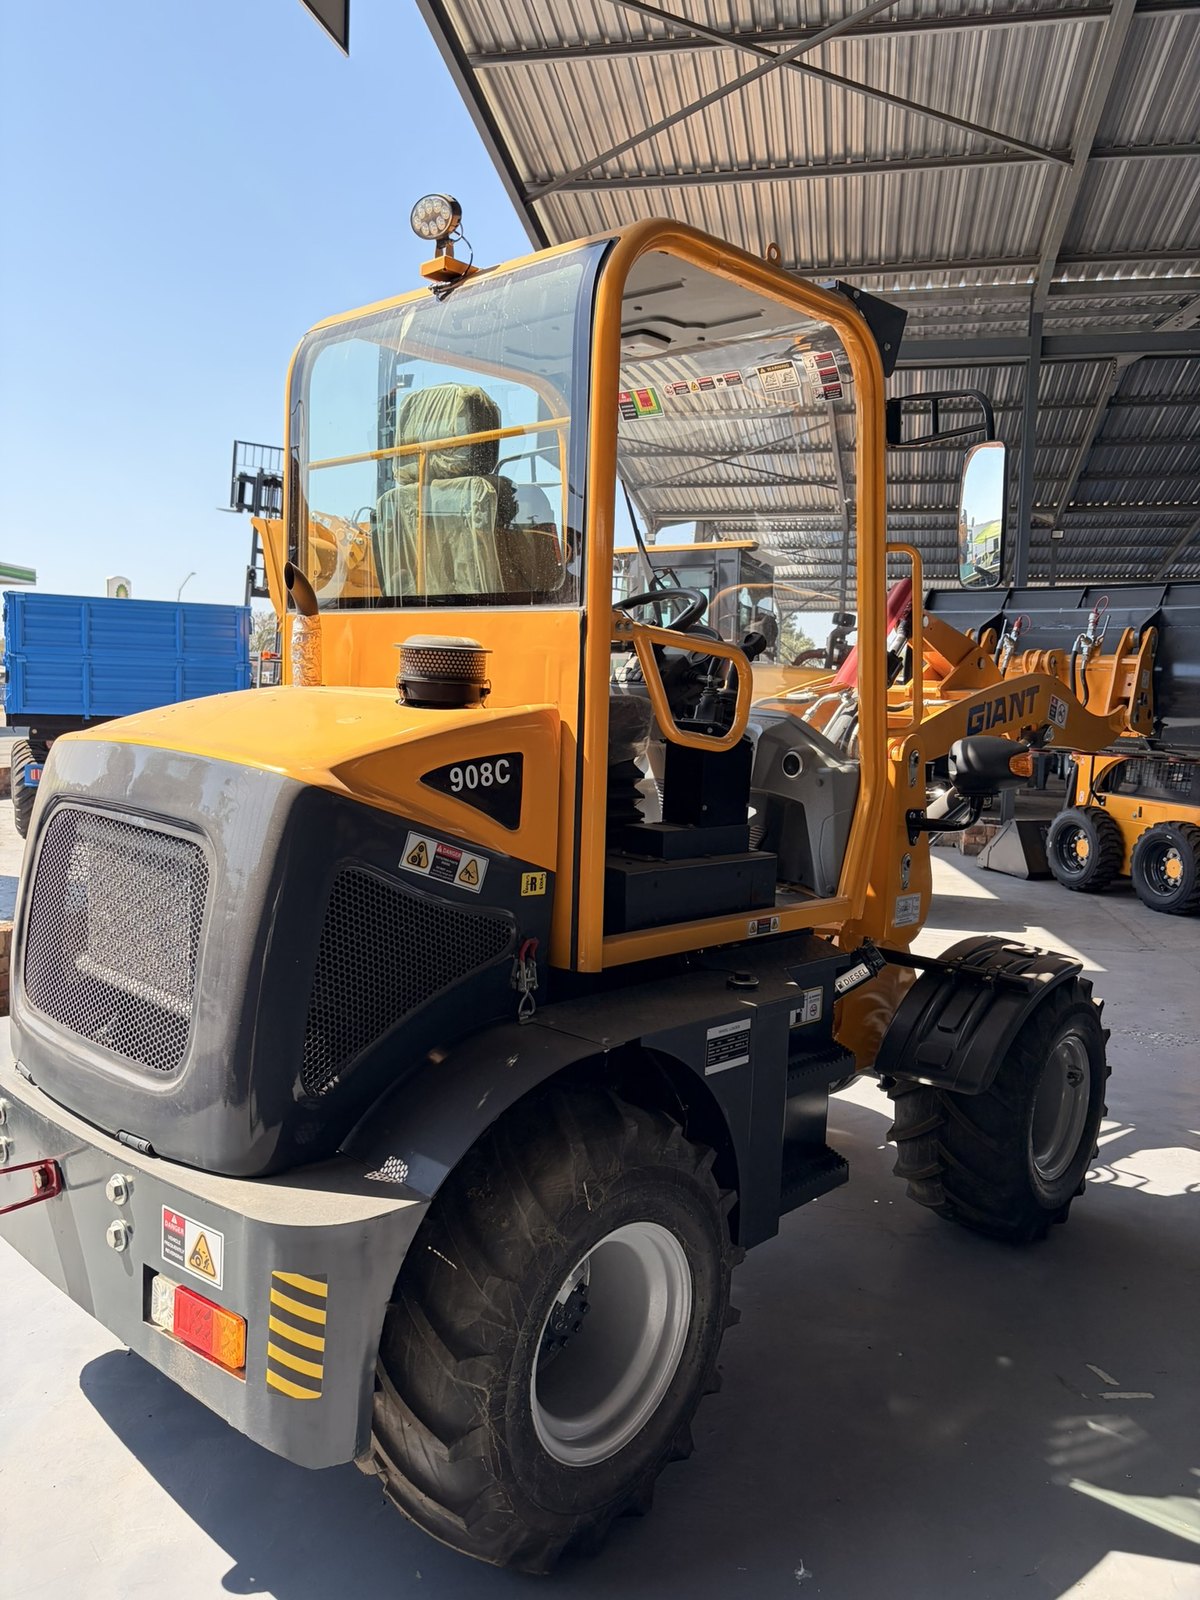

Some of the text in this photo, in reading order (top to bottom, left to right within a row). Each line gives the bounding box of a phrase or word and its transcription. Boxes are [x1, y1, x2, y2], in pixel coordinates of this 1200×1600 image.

[967, 685, 1040, 736] GIANT
[450, 759, 510, 792] 908C
[843, 968, 868, 986] DIESEL
[164, 1220, 185, 1235] DANGER
